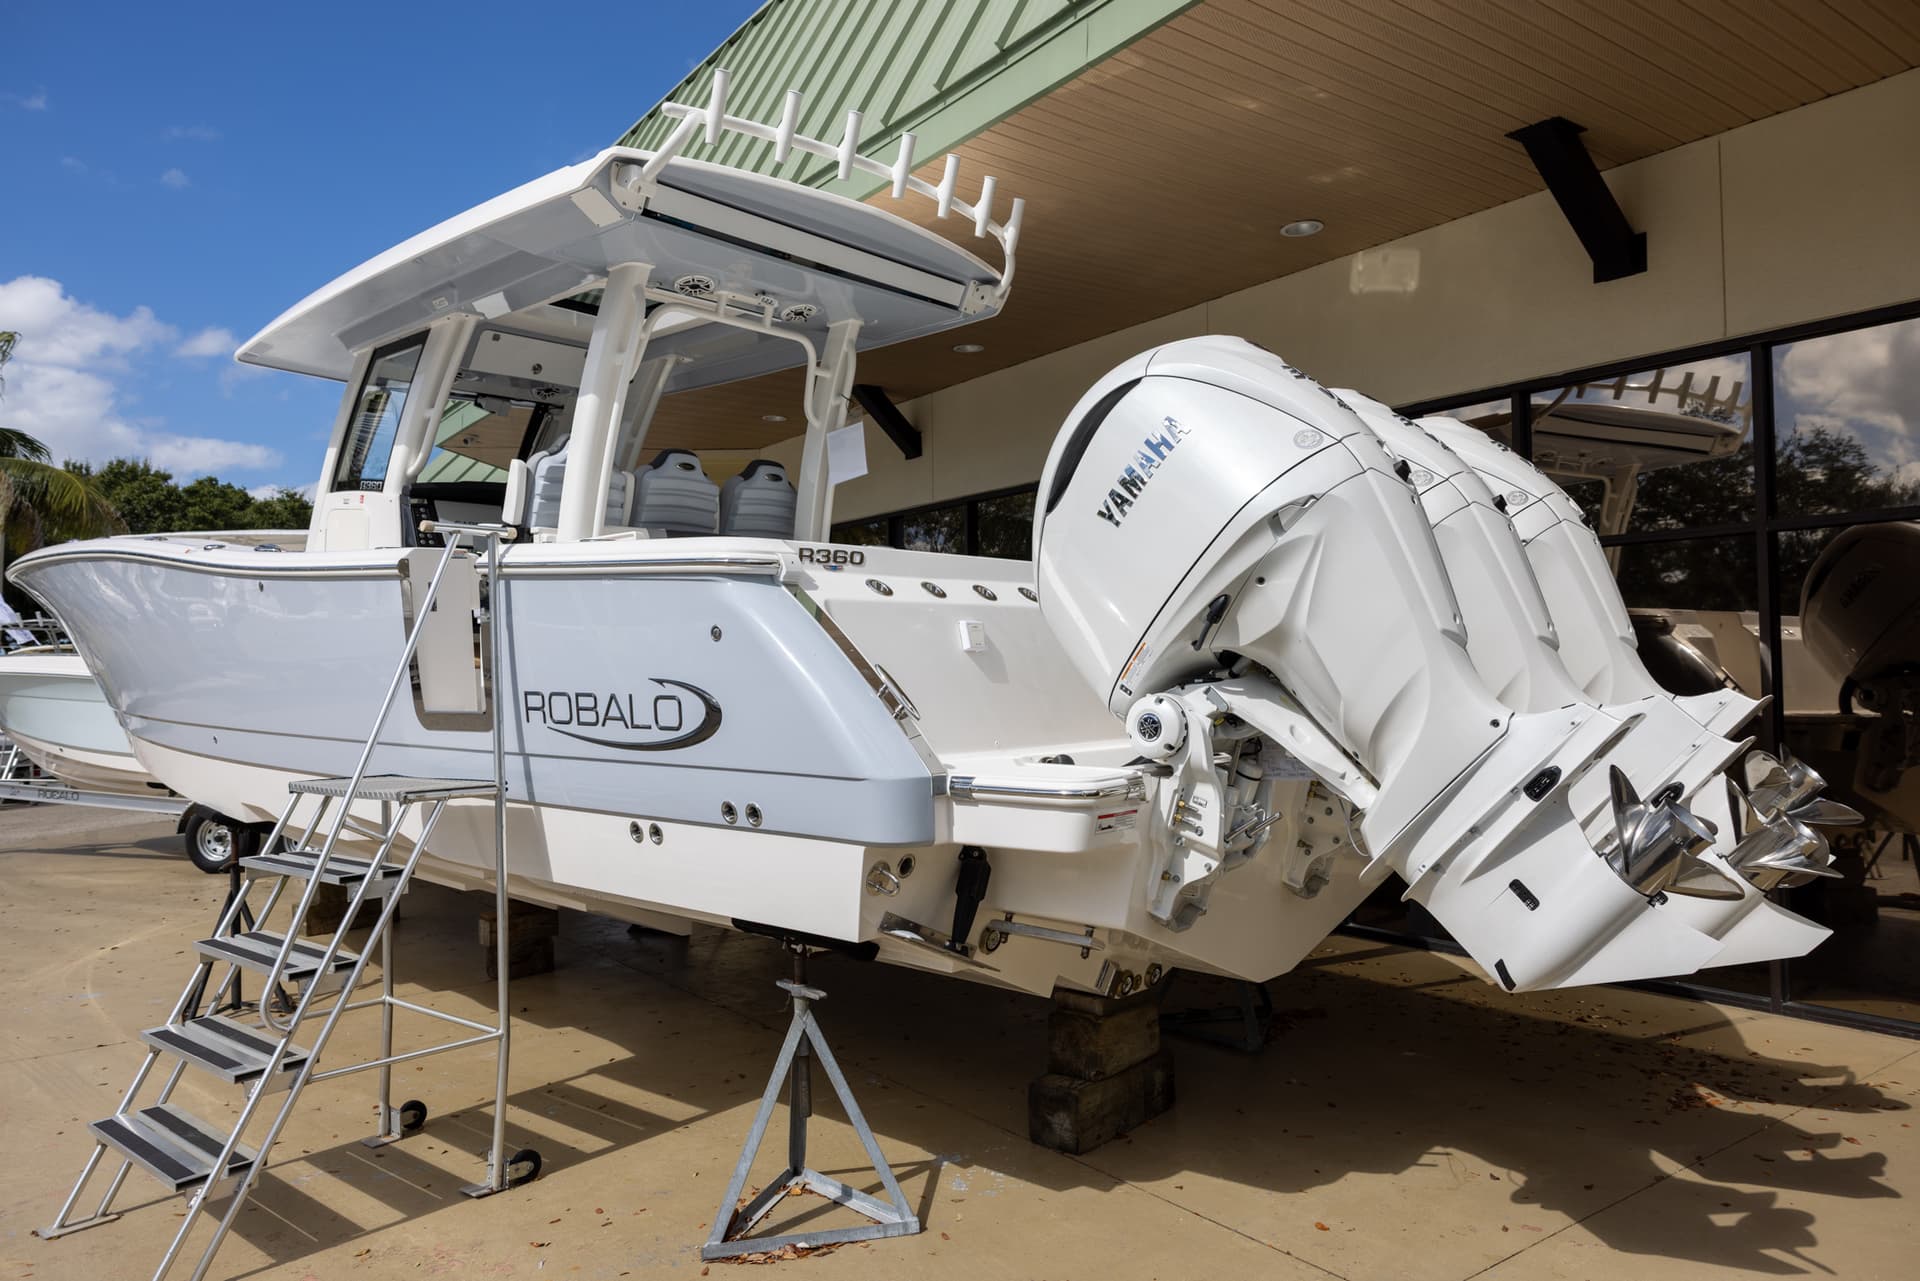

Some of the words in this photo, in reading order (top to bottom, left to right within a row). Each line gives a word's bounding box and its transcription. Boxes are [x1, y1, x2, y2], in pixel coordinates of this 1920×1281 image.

[1097, 416, 1191, 528] YAMAHA
[798, 547, 865, 565] R360
[524, 690, 683, 731] ROBALO
